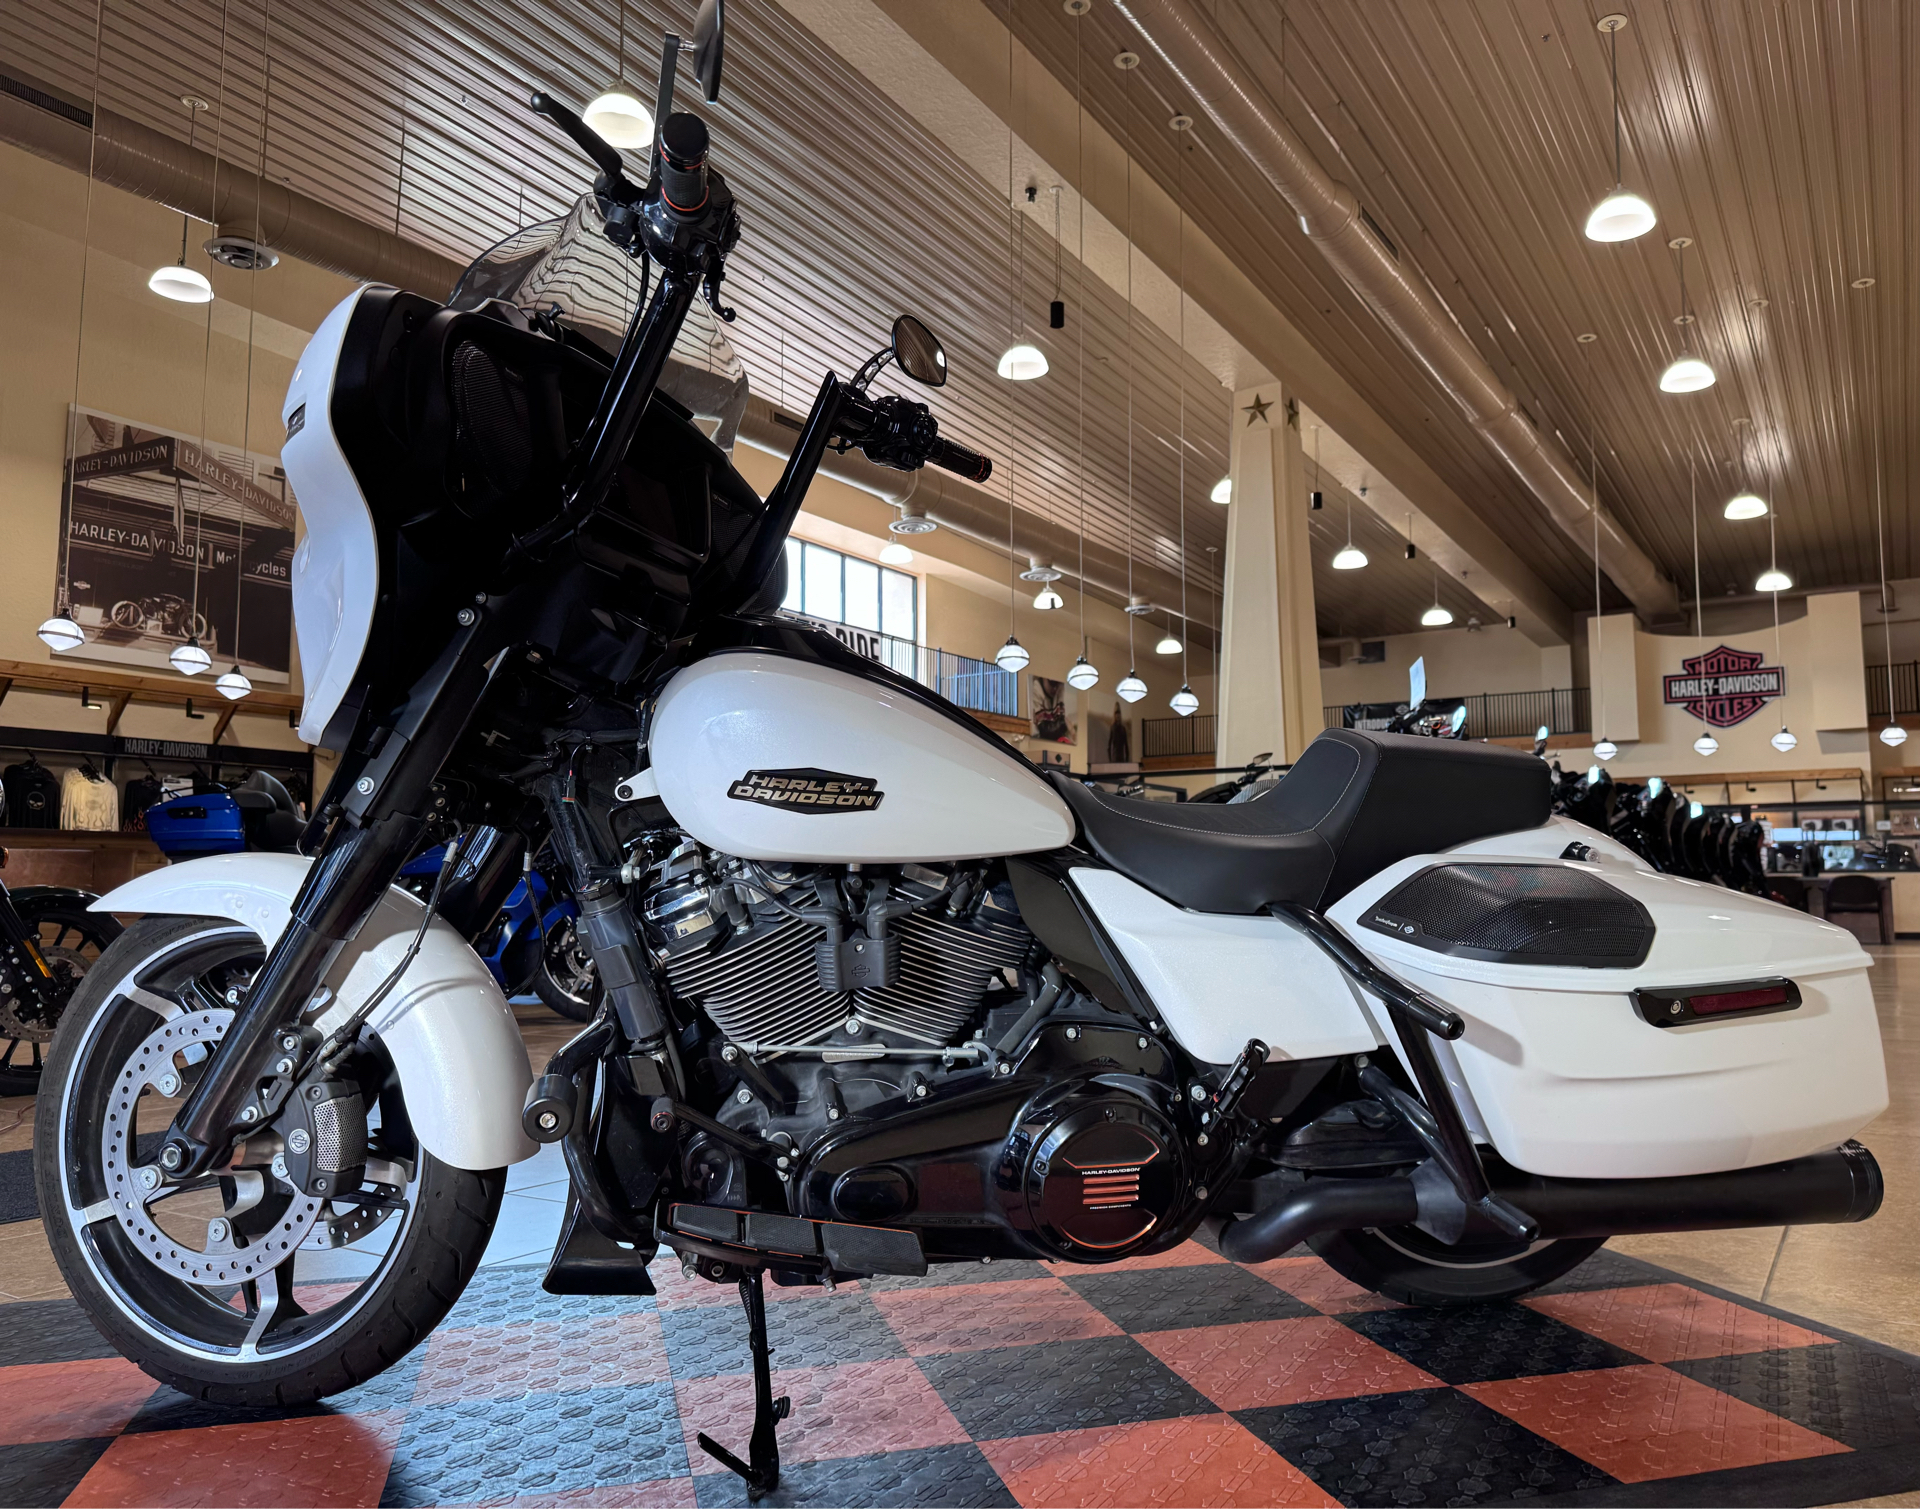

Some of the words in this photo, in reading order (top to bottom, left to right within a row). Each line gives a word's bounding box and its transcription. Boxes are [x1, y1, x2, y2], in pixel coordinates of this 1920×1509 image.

[184, 449, 294, 523] HARLEY-DAVIDSON
[1694, 653, 1751, 674] MOTOR
[1671, 673, 1778, 698] HARLEY-DAVIDSON
[1696, 698, 1753, 720] CYCLES
[125, 739, 208, 758] HARLEY-DAVIDSON
[748, 774, 869, 793] HARLEY-
[734, 785, 876, 806] DAVIDSON
[1082, 1167, 1140, 1175] HARLEY-DAVIDSON
